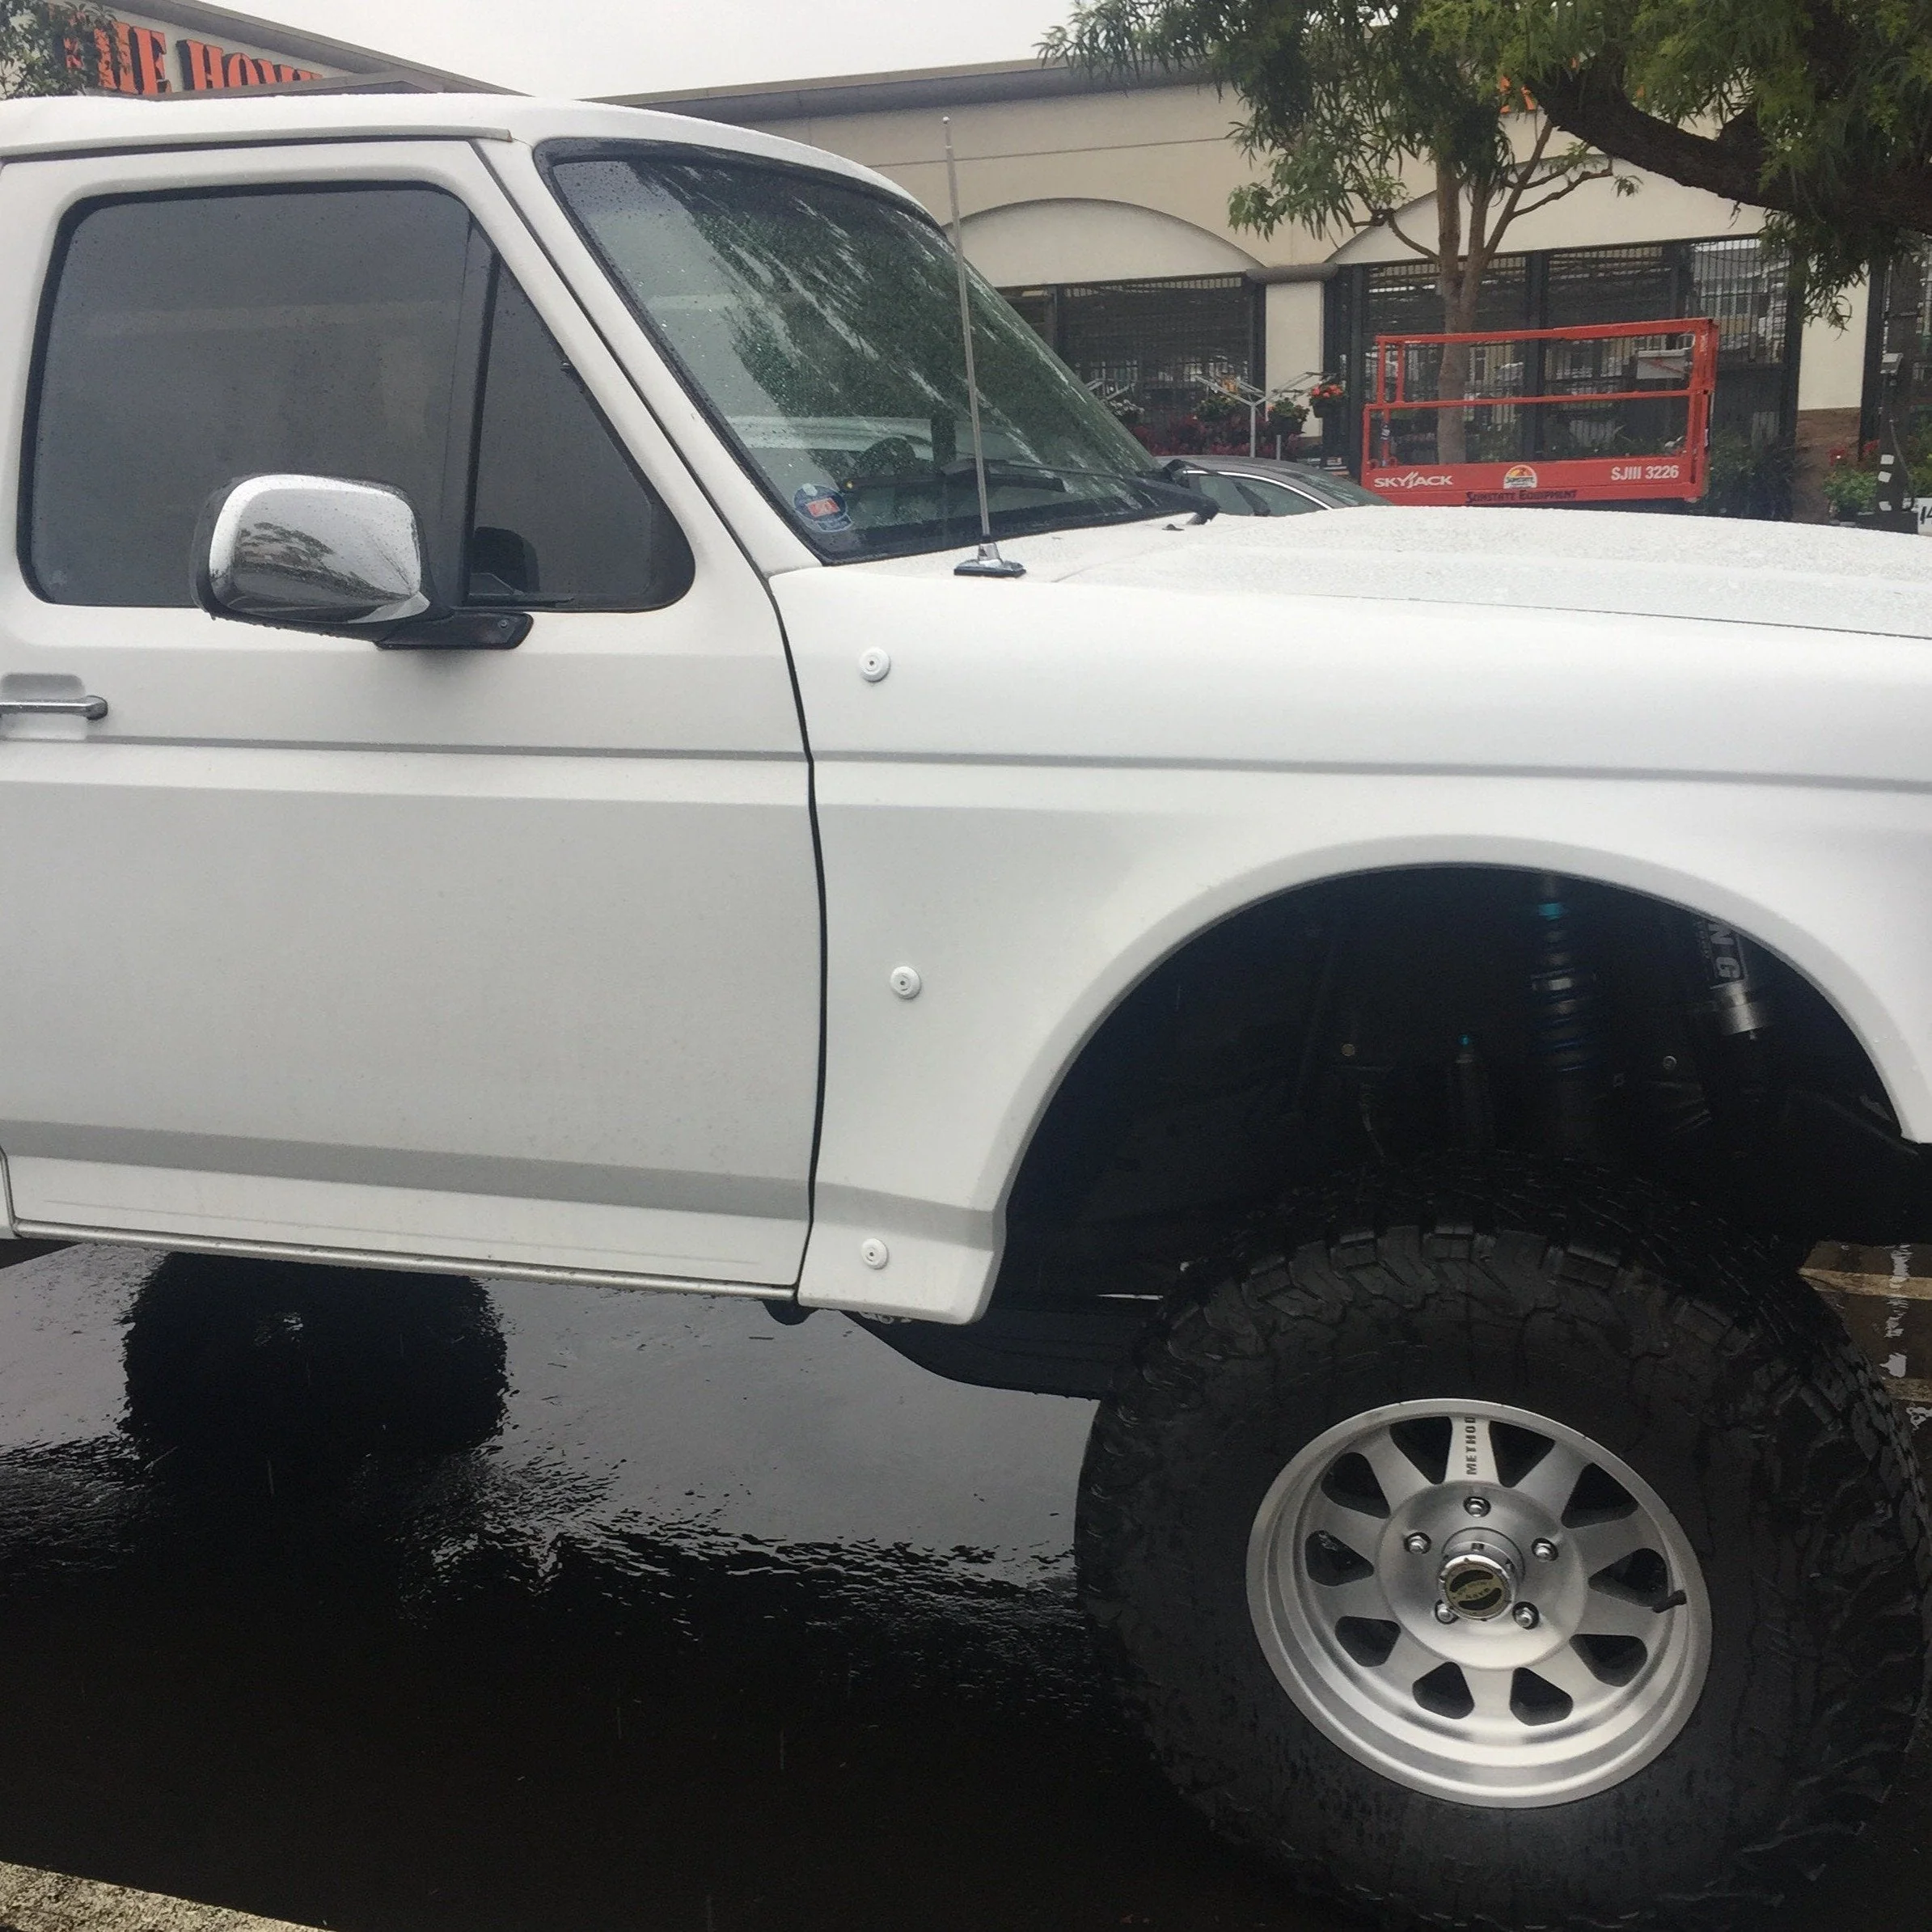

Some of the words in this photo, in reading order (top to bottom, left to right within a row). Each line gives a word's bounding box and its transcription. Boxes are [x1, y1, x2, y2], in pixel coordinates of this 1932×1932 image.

[177, 39, 323, 90] HO
[1374, 471, 1453, 488] SKYJACK
[1645, 465, 1680, 480] 3226
[1464, 1417, 1477, 1475] METHOD
